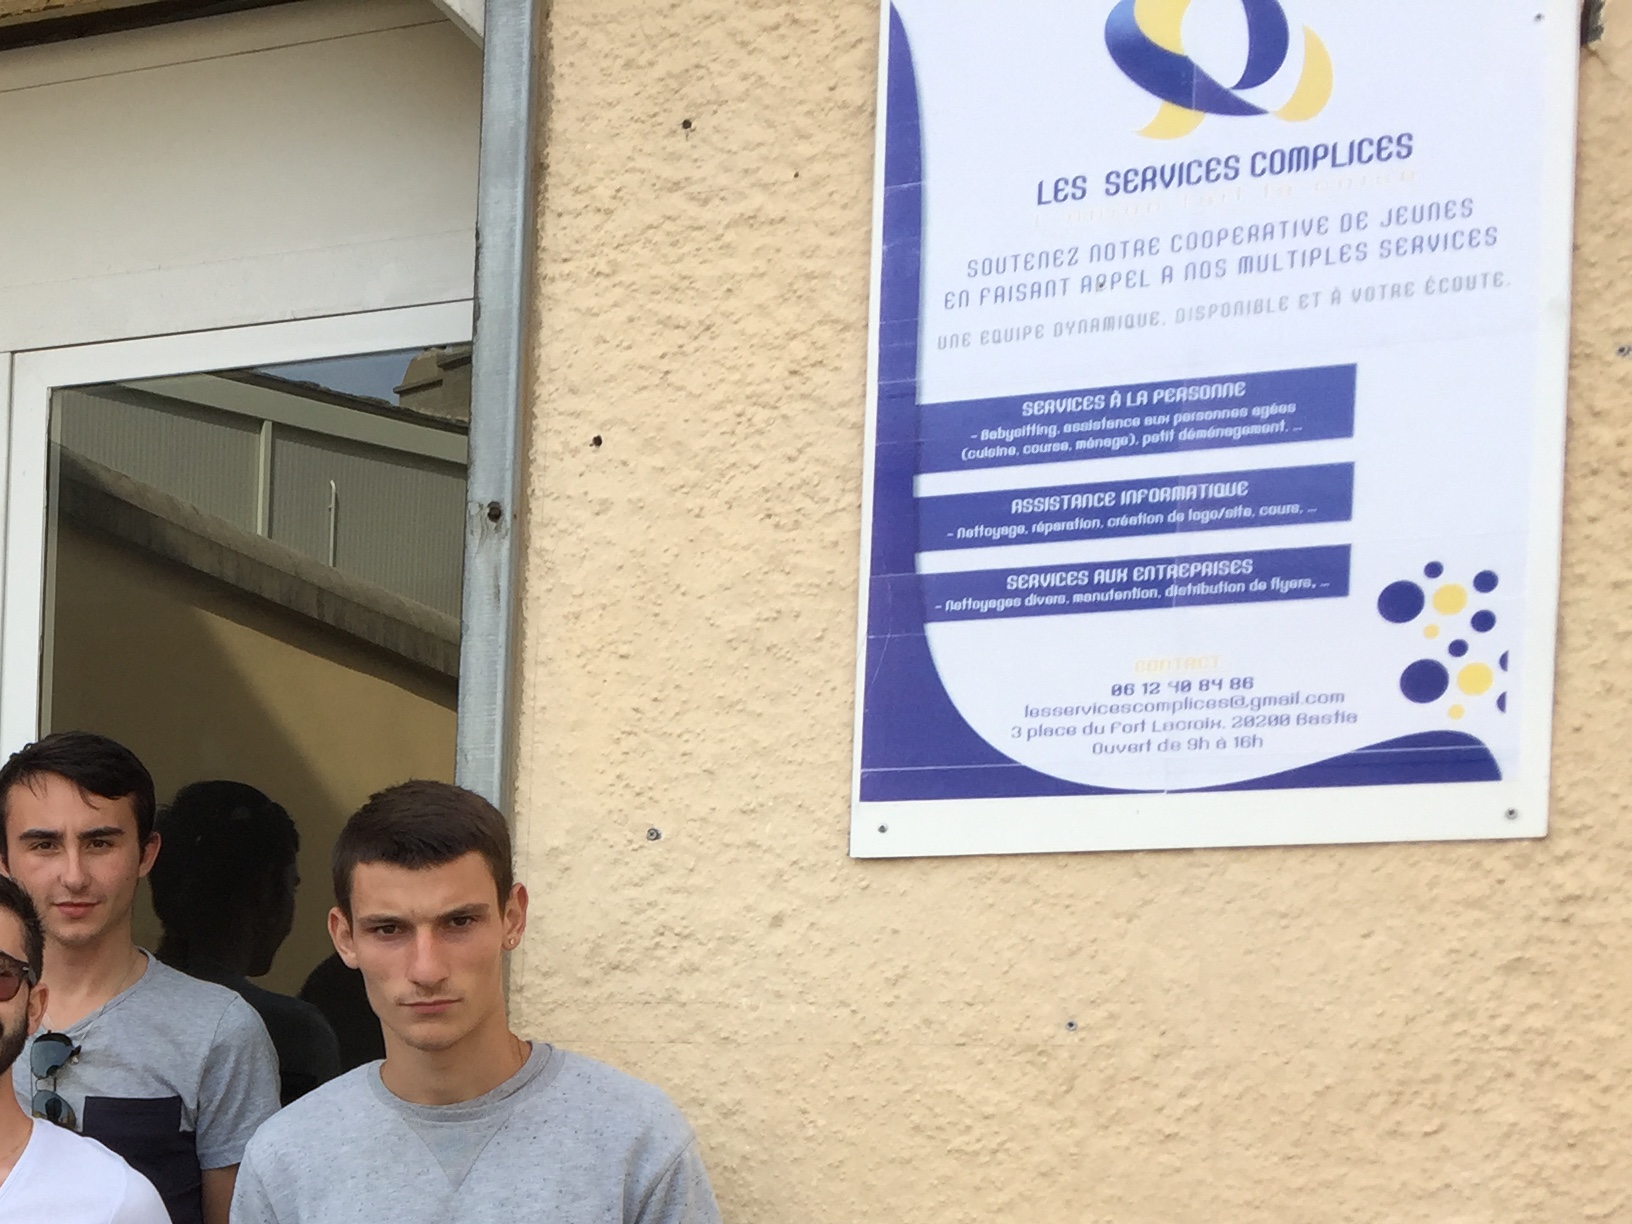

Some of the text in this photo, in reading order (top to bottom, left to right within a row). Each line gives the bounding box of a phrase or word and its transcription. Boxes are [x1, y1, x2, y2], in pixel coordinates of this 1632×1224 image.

[1037, 132, 1414, 206] LES SERVICES COMPLICES
[967, 197, 1474, 278] SOUTENEZ NOTRE COOPERATIVE DE JEUNES
[944, 226, 1498, 310] EN FAISANT APPEL A NOS MULTIPLES SERVICES
[937, 331, 971, 351] UNE
[980, 323, 1045, 346] EQUIPE
[1175, 295, 1289, 324] DISPONIBLE
[1298, 291, 1323, 311] ET
[1330, 286, 1341, 306] À
[1351, 281, 1416, 304] VOTRE
[1425, 270, 1511, 295] ÉCOUTE.
[1022, 381, 1247, 417] SERVICES À LA PERSONNE
[1063, 416, 1141, 433] assistance
[1144, 413, 1170, 427] aux
[1174, 407, 1249, 427] personnes
[1142, 428, 1175, 447] petit
[1011, 481, 1249, 514] ASSISTANCE INFORMATIQUE
[1107, 511, 1164, 528] création
[1168, 509, 1185, 524] de
[1006, 558, 1253, 590] SERVICES AUX ENTREPRISES
[945, 596, 1022, 613] Nettoyages
[1165, 580, 1246, 599] distribution
[1249, 578, 1267, 593] de
[1111, 676, 1255, 697] 06 12 40 84 86
[1024, 690, 1345, 718] lesservicescomplices@gmail.com
[1011, 726, 1022, 739] 3
[1026, 723, 1077, 742] place
[1082, 721, 1106, 736] du
[1110, 719, 1146, 734] Fort
[1231, 713, 1291, 729] 20200
[1296, 709, 1358, 726] Bastia
[1092, 734, 1264, 755] Ouvert de 9h à 16h
